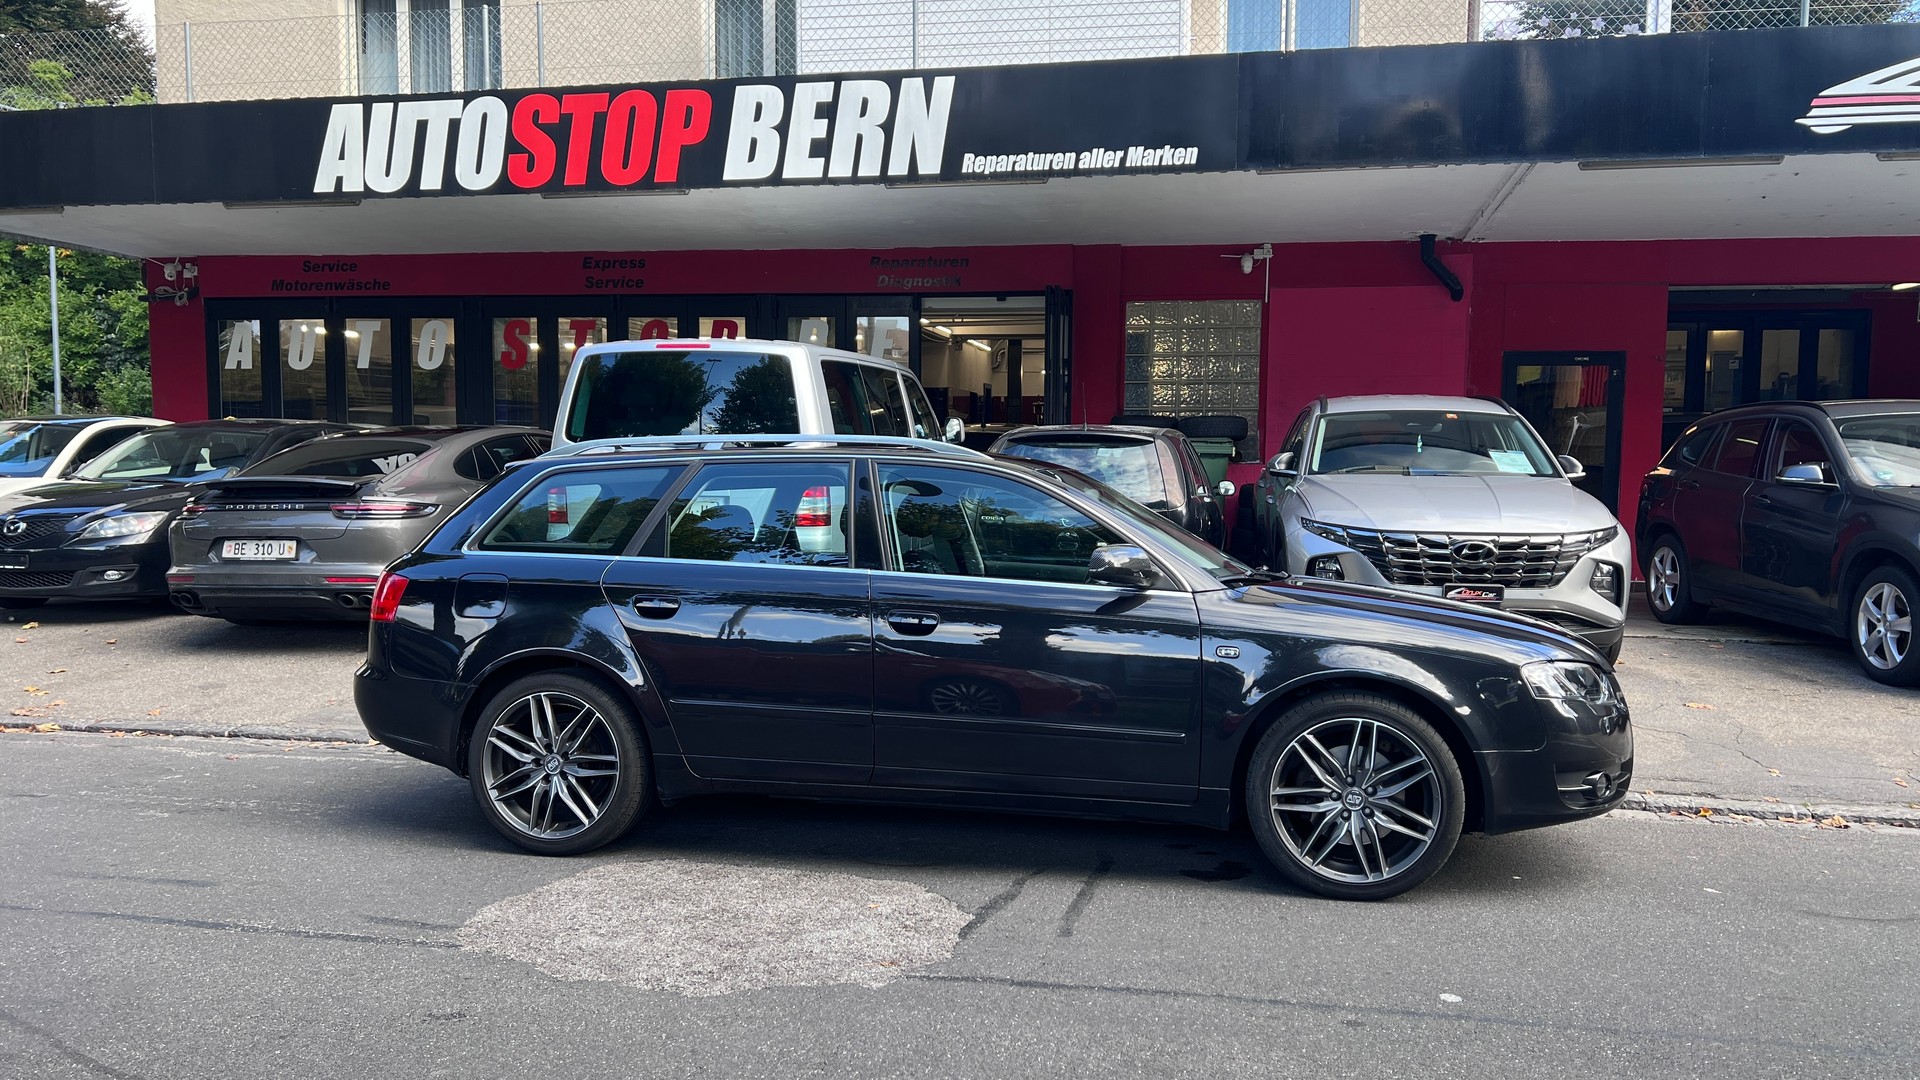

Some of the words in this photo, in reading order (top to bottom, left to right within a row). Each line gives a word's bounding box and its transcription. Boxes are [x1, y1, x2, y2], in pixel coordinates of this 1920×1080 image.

[722, 75, 956, 181] BERN
[961, 150, 1076, 175] Reparaturen
[1079, 148, 1125, 170] aller
[1127, 144, 1199, 168] Marken
[302, 259, 358, 273] Service
[582, 256, 647, 272] Express
[869, 255, 970, 272] Reparaturen
[271, 278, 391, 292] Motorenwäsche
[585, 275, 645, 289] Service
[877, 273, 962, 290] Diagnostik
[233, 543, 247, 555] BE
[253, 543, 273, 556] 310
[278, 543, 285, 555] U
